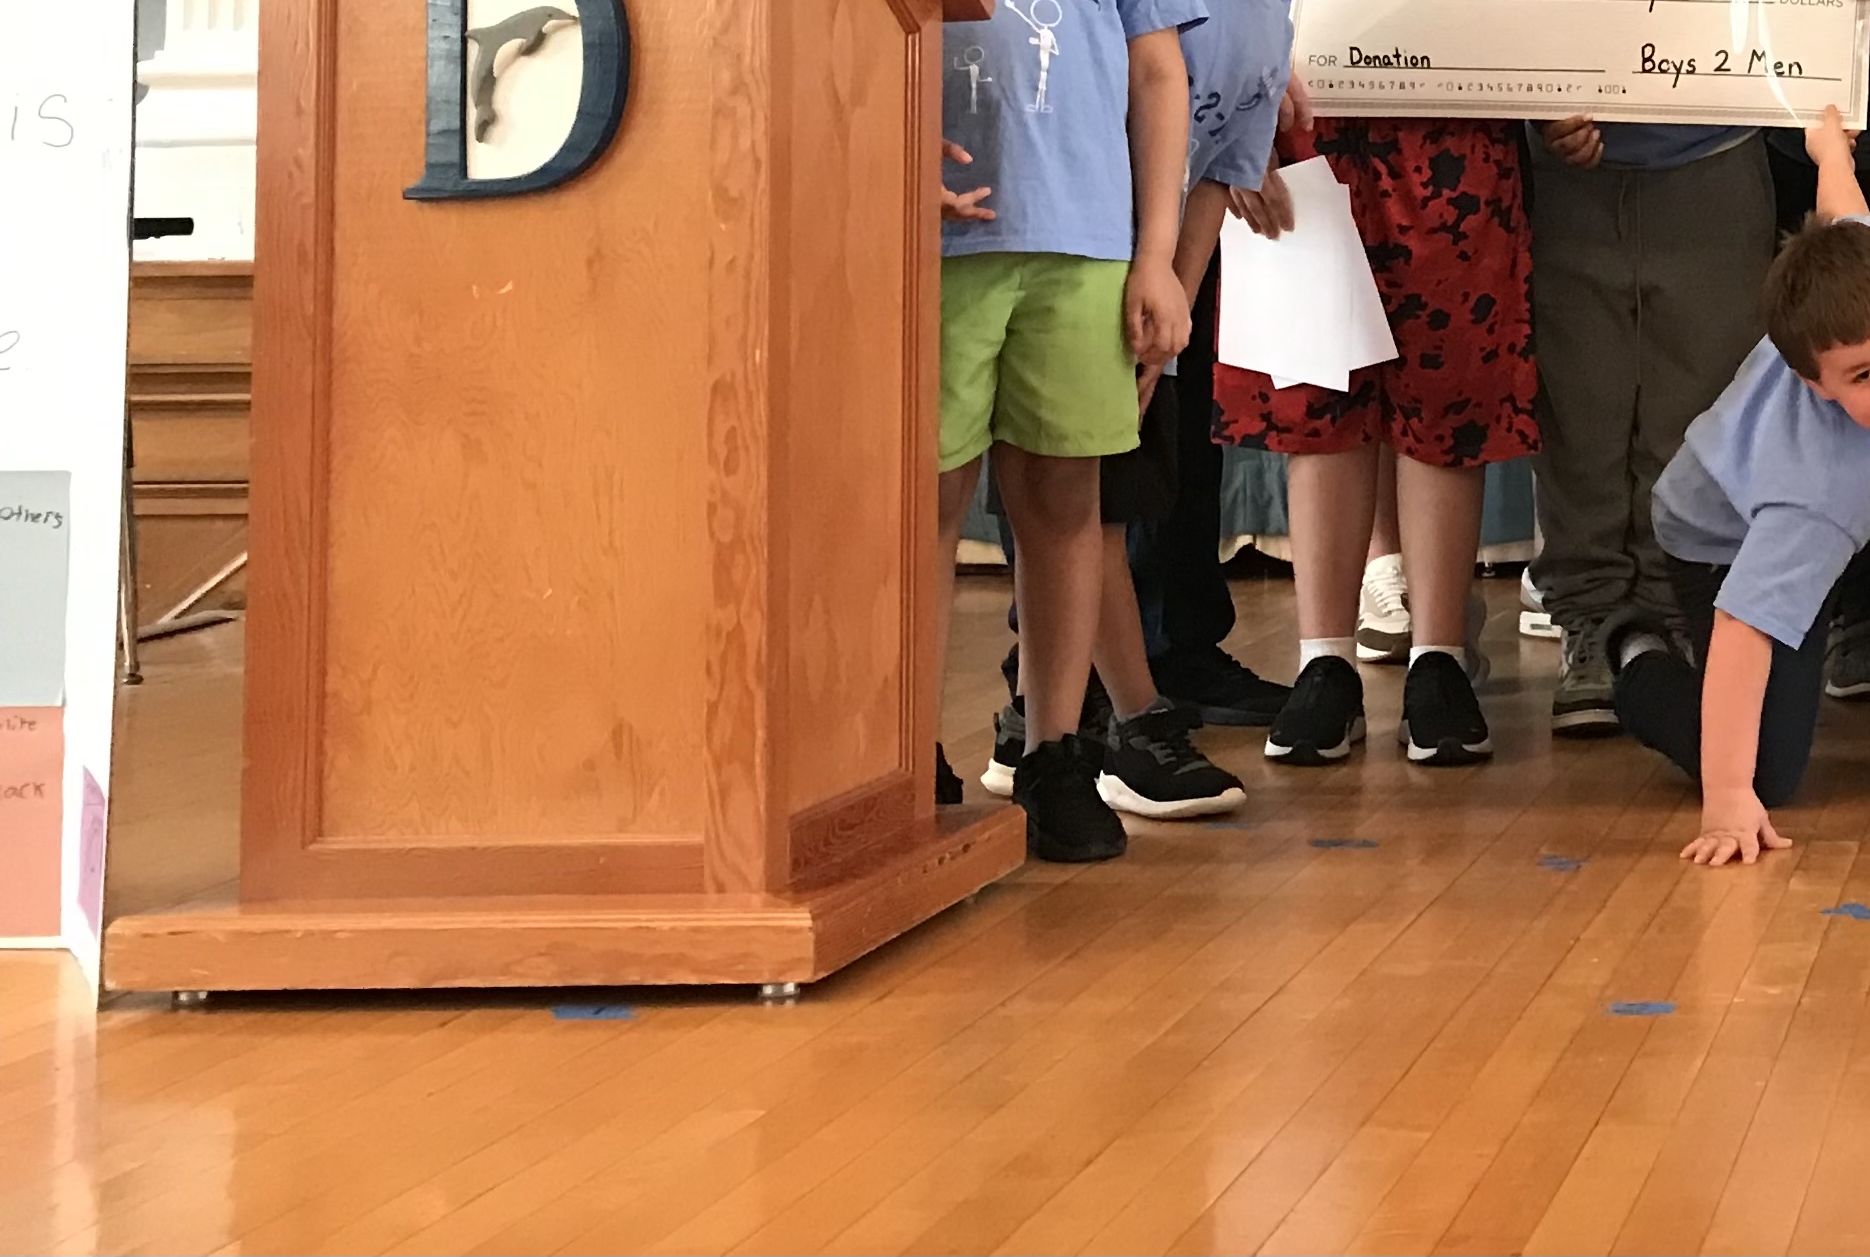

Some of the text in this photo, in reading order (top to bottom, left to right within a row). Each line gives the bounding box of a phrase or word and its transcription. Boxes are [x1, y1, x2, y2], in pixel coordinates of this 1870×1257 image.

[1308, 54, 1338, 67] FOR
[1348, 45, 1431, 69] Donation
[1641, 42, 1803, 89] Boys 2 Men
